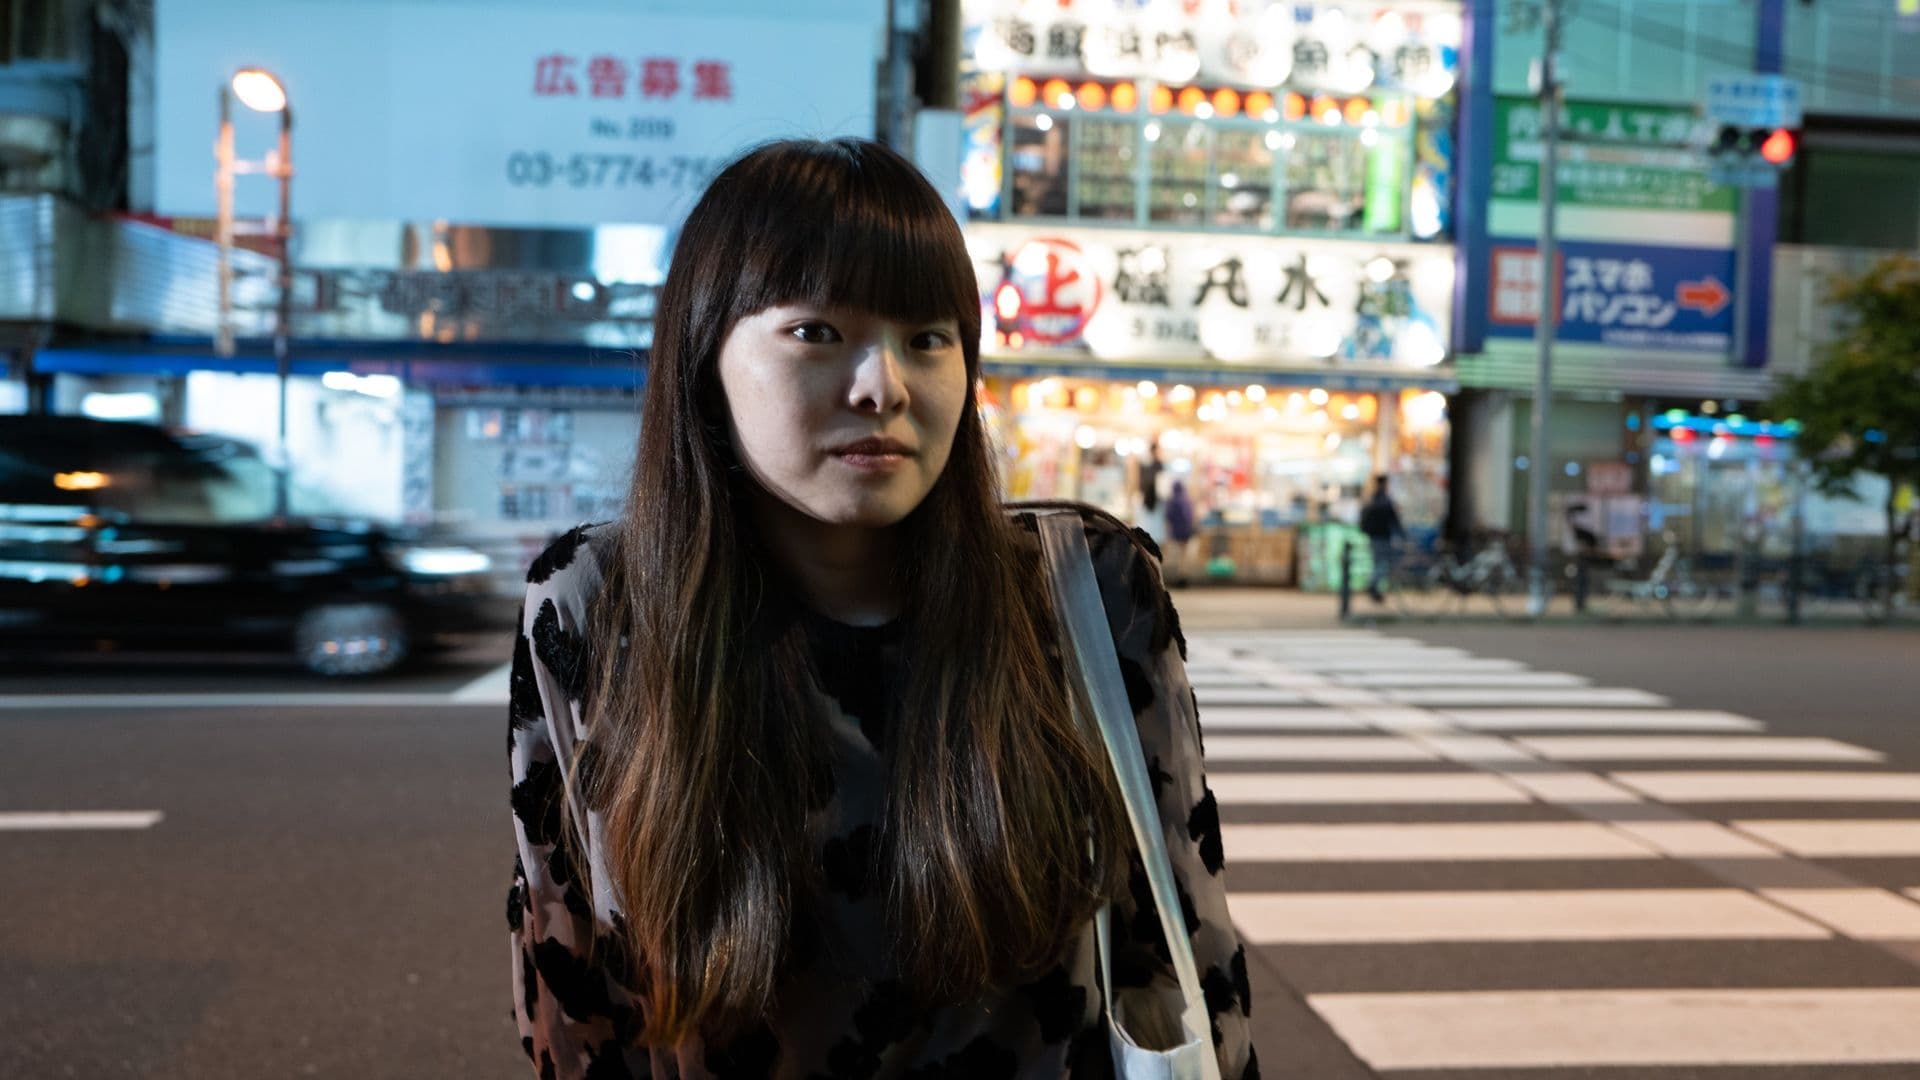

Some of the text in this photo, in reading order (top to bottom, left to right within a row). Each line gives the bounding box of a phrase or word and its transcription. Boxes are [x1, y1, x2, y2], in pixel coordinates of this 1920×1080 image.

[534, 54, 734, 101] 広告募集
[1565, 257, 1655, 290] スマホ
[1563, 293, 1677, 327] パソコン
